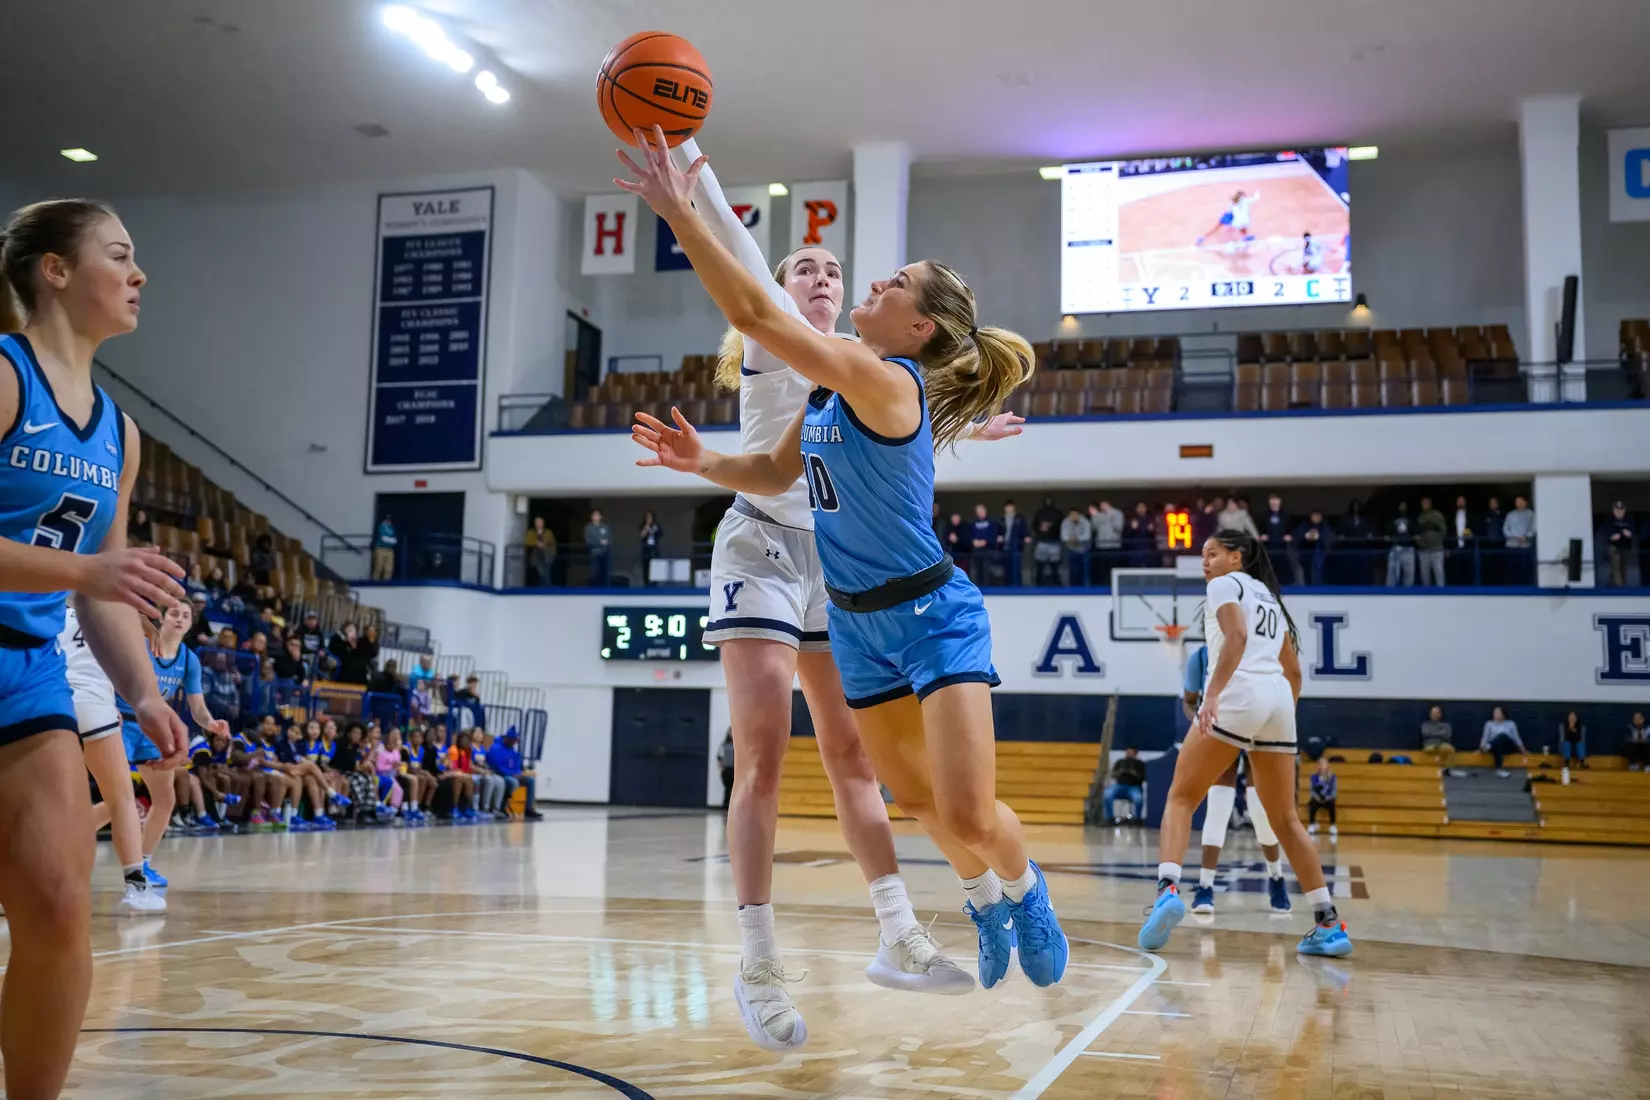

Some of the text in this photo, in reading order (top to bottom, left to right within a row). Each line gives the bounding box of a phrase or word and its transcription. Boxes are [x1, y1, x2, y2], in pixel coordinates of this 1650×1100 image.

[652, 78, 709, 110] ELITE
[412, 200, 461, 216] YALE
[802, 200, 838, 245] P
[593, 212, 626, 256] H
[1142, 287, 1160, 304] Y
[1179, 287, 1190, 301] 2
[1273, 282, 1285, 297] 2
[1306, 280, 1320, 298] C
[29, 491, 99, 553] 5
[1167, 523, 1192, 549] 14
[723, 580, 745, 612] Y
[1255, 604, 1277, 639] 20
[616, 627, 631, 649] 2
[679, 644, 688, 660] 1
